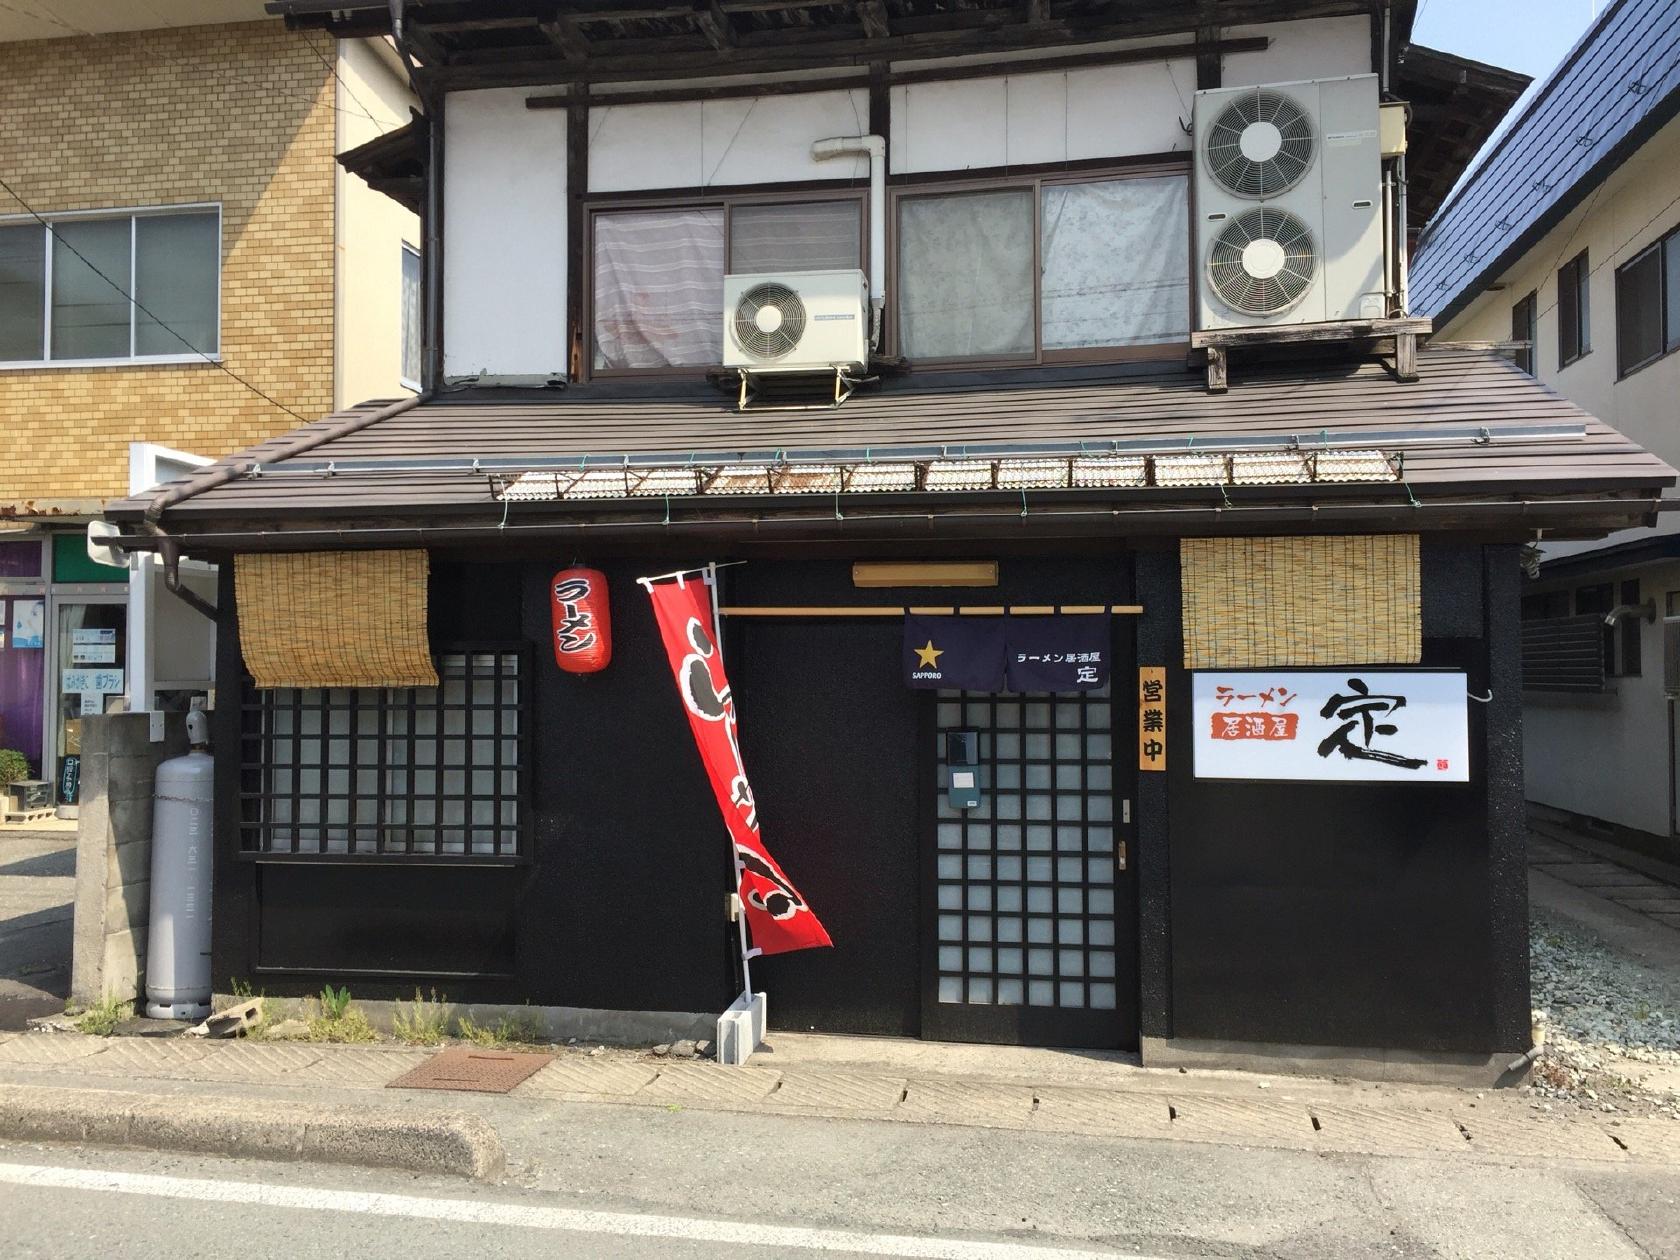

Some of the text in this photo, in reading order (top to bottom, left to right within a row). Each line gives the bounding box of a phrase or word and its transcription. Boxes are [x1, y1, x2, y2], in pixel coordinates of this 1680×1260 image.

[1017, 651, 1101, 664] ラーメン居酒屋
[912, 671, 942, 681] SAPPORO
[1076, 666, 1098, 684] 定
[1216, 685, 1297, 708] ラーメン
[1142, 680, 1163, 762] 営業中
[1221, 715, 1289, 739] 居酒屋
[1317, 678, 1429, 769] 定
